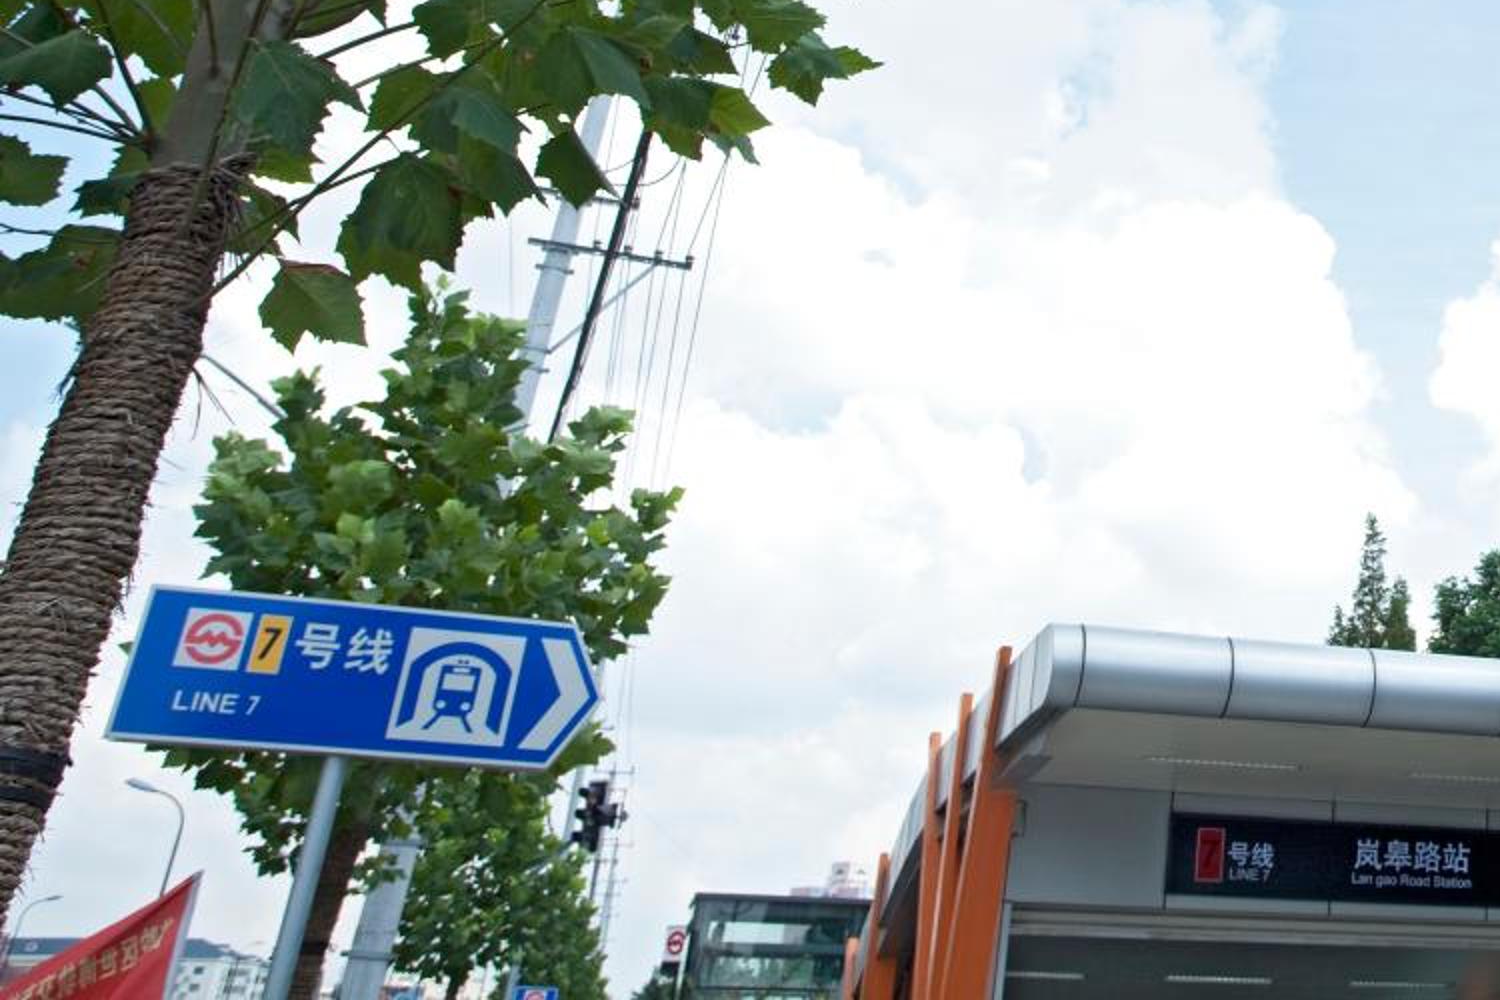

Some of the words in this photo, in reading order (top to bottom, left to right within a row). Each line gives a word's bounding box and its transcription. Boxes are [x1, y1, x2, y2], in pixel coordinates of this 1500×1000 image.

[171, 690, 237, 716] LINE
[244, 696, 261, 717] 7
[1229, 868, 1260, 882] LINE
[1400, 874, 1431, 888] Road
[1433, 875, 1473, 889] Station
